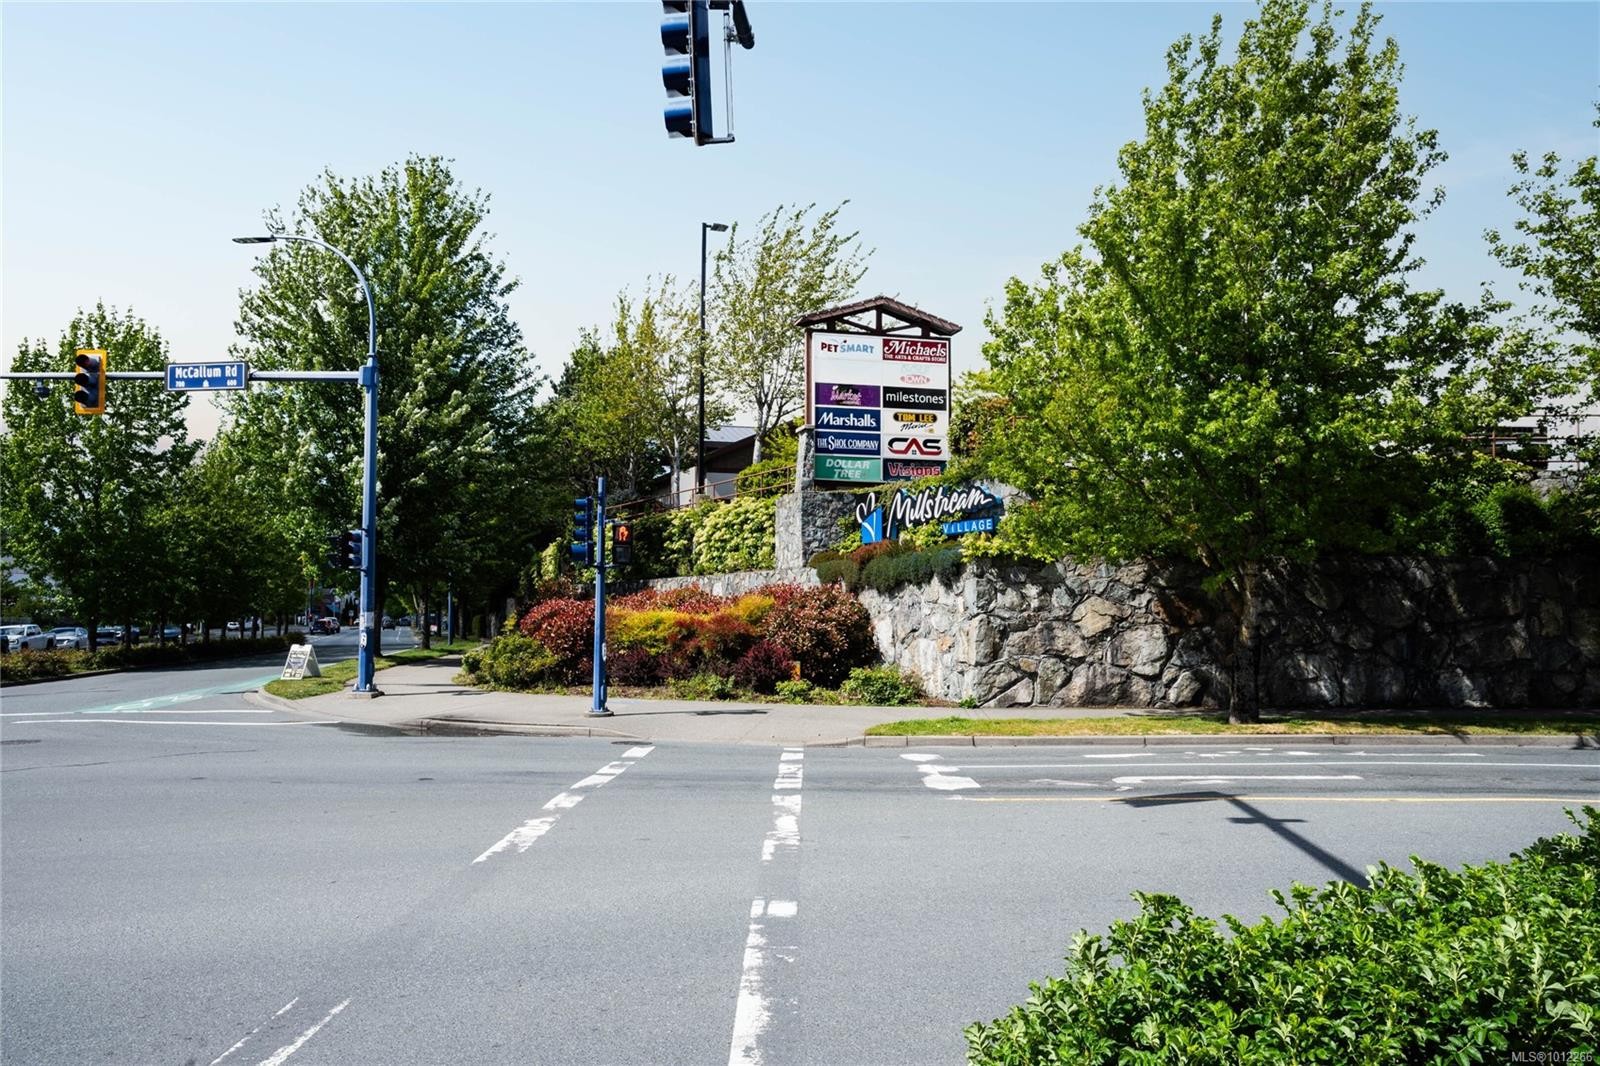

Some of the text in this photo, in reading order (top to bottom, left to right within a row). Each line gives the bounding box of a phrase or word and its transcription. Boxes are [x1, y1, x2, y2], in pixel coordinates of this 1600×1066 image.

[884, 340, 947, 356] Michaels
[176, 365, 237, 378] McCallum Rd
[886, 392, 944, 404] milestones
[818, 412, 876, 428] Marshalls
[896, 412, 934, 422] TOM LEE
[848, 438, 879, 451] COMPANY
[826, 458, 870, 468] DOLLAR
[888, 462, 940, 477] Visions
[834, 468, 862, 478] TREE
[886, 486, 992, 538] Millstream
